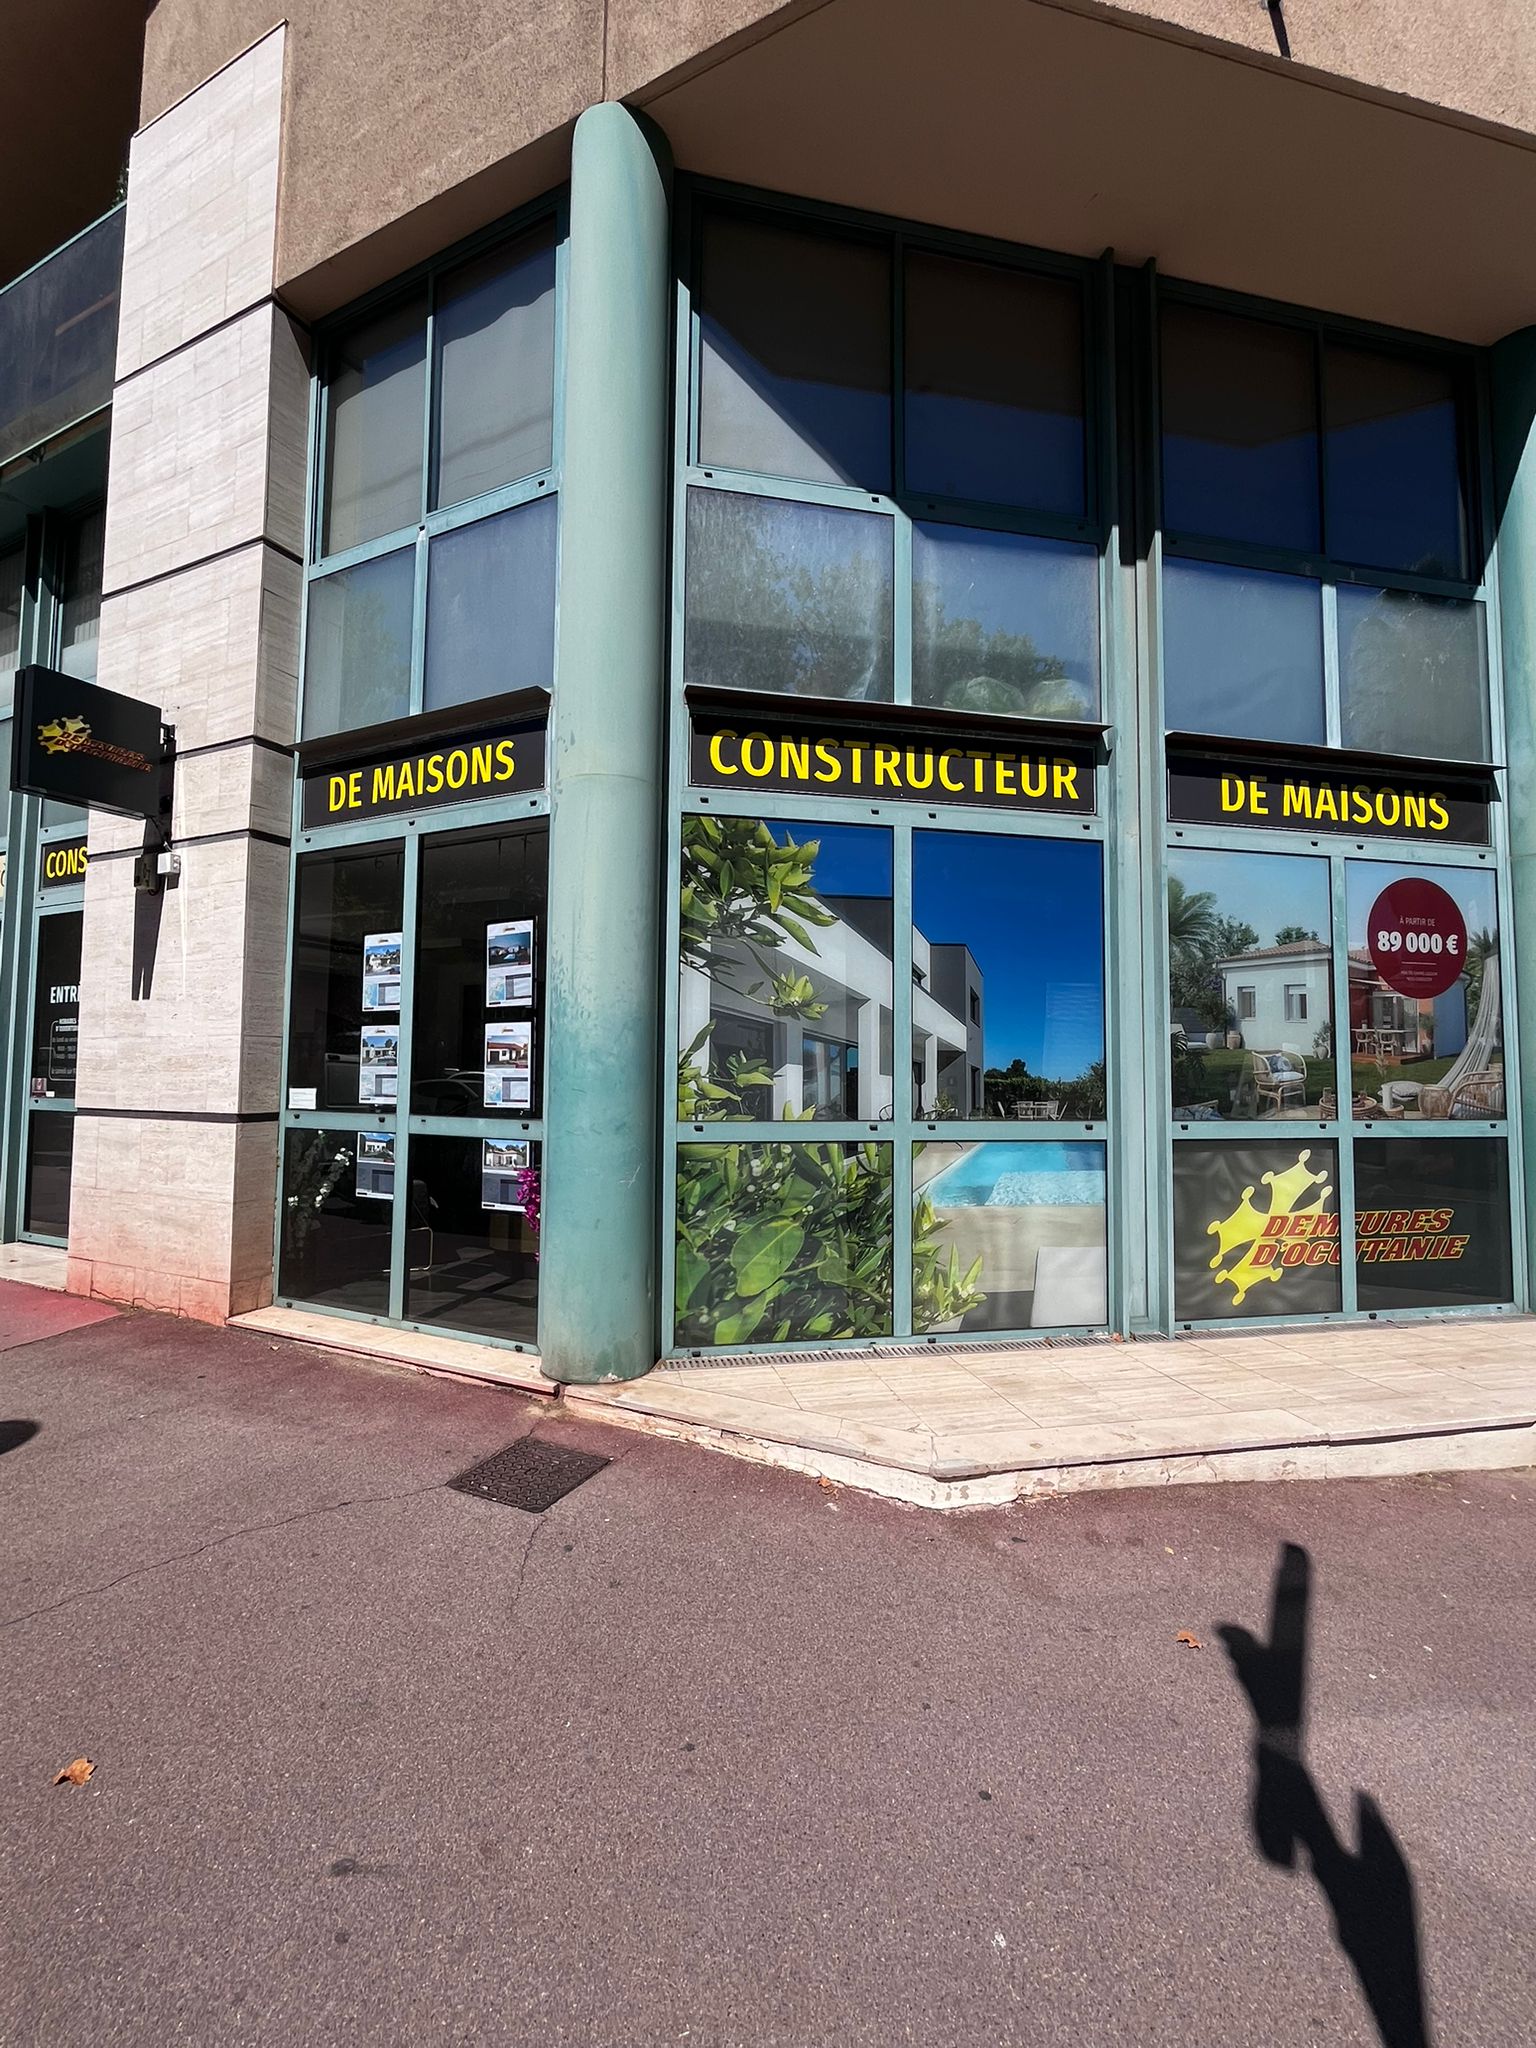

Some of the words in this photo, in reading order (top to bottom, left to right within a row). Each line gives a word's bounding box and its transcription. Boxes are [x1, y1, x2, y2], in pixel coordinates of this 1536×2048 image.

[328, 771, 363, 812] DE
[372, 740, 515, 804] MAISONS
[709, 729, 1080, 800] CONSTRUCTEUR
[1221, 772, 1269, 815] DE
[1283, 778, 1450, 831] MAISONS
[1377, 930, 1402, 952] 89
[1405, 932, 1443, 954] 000
[1446, 934, 1459, 955] €
[1406, 918, 1426, 926] PARTIR
[1428, 918, 1436, 926] DE
